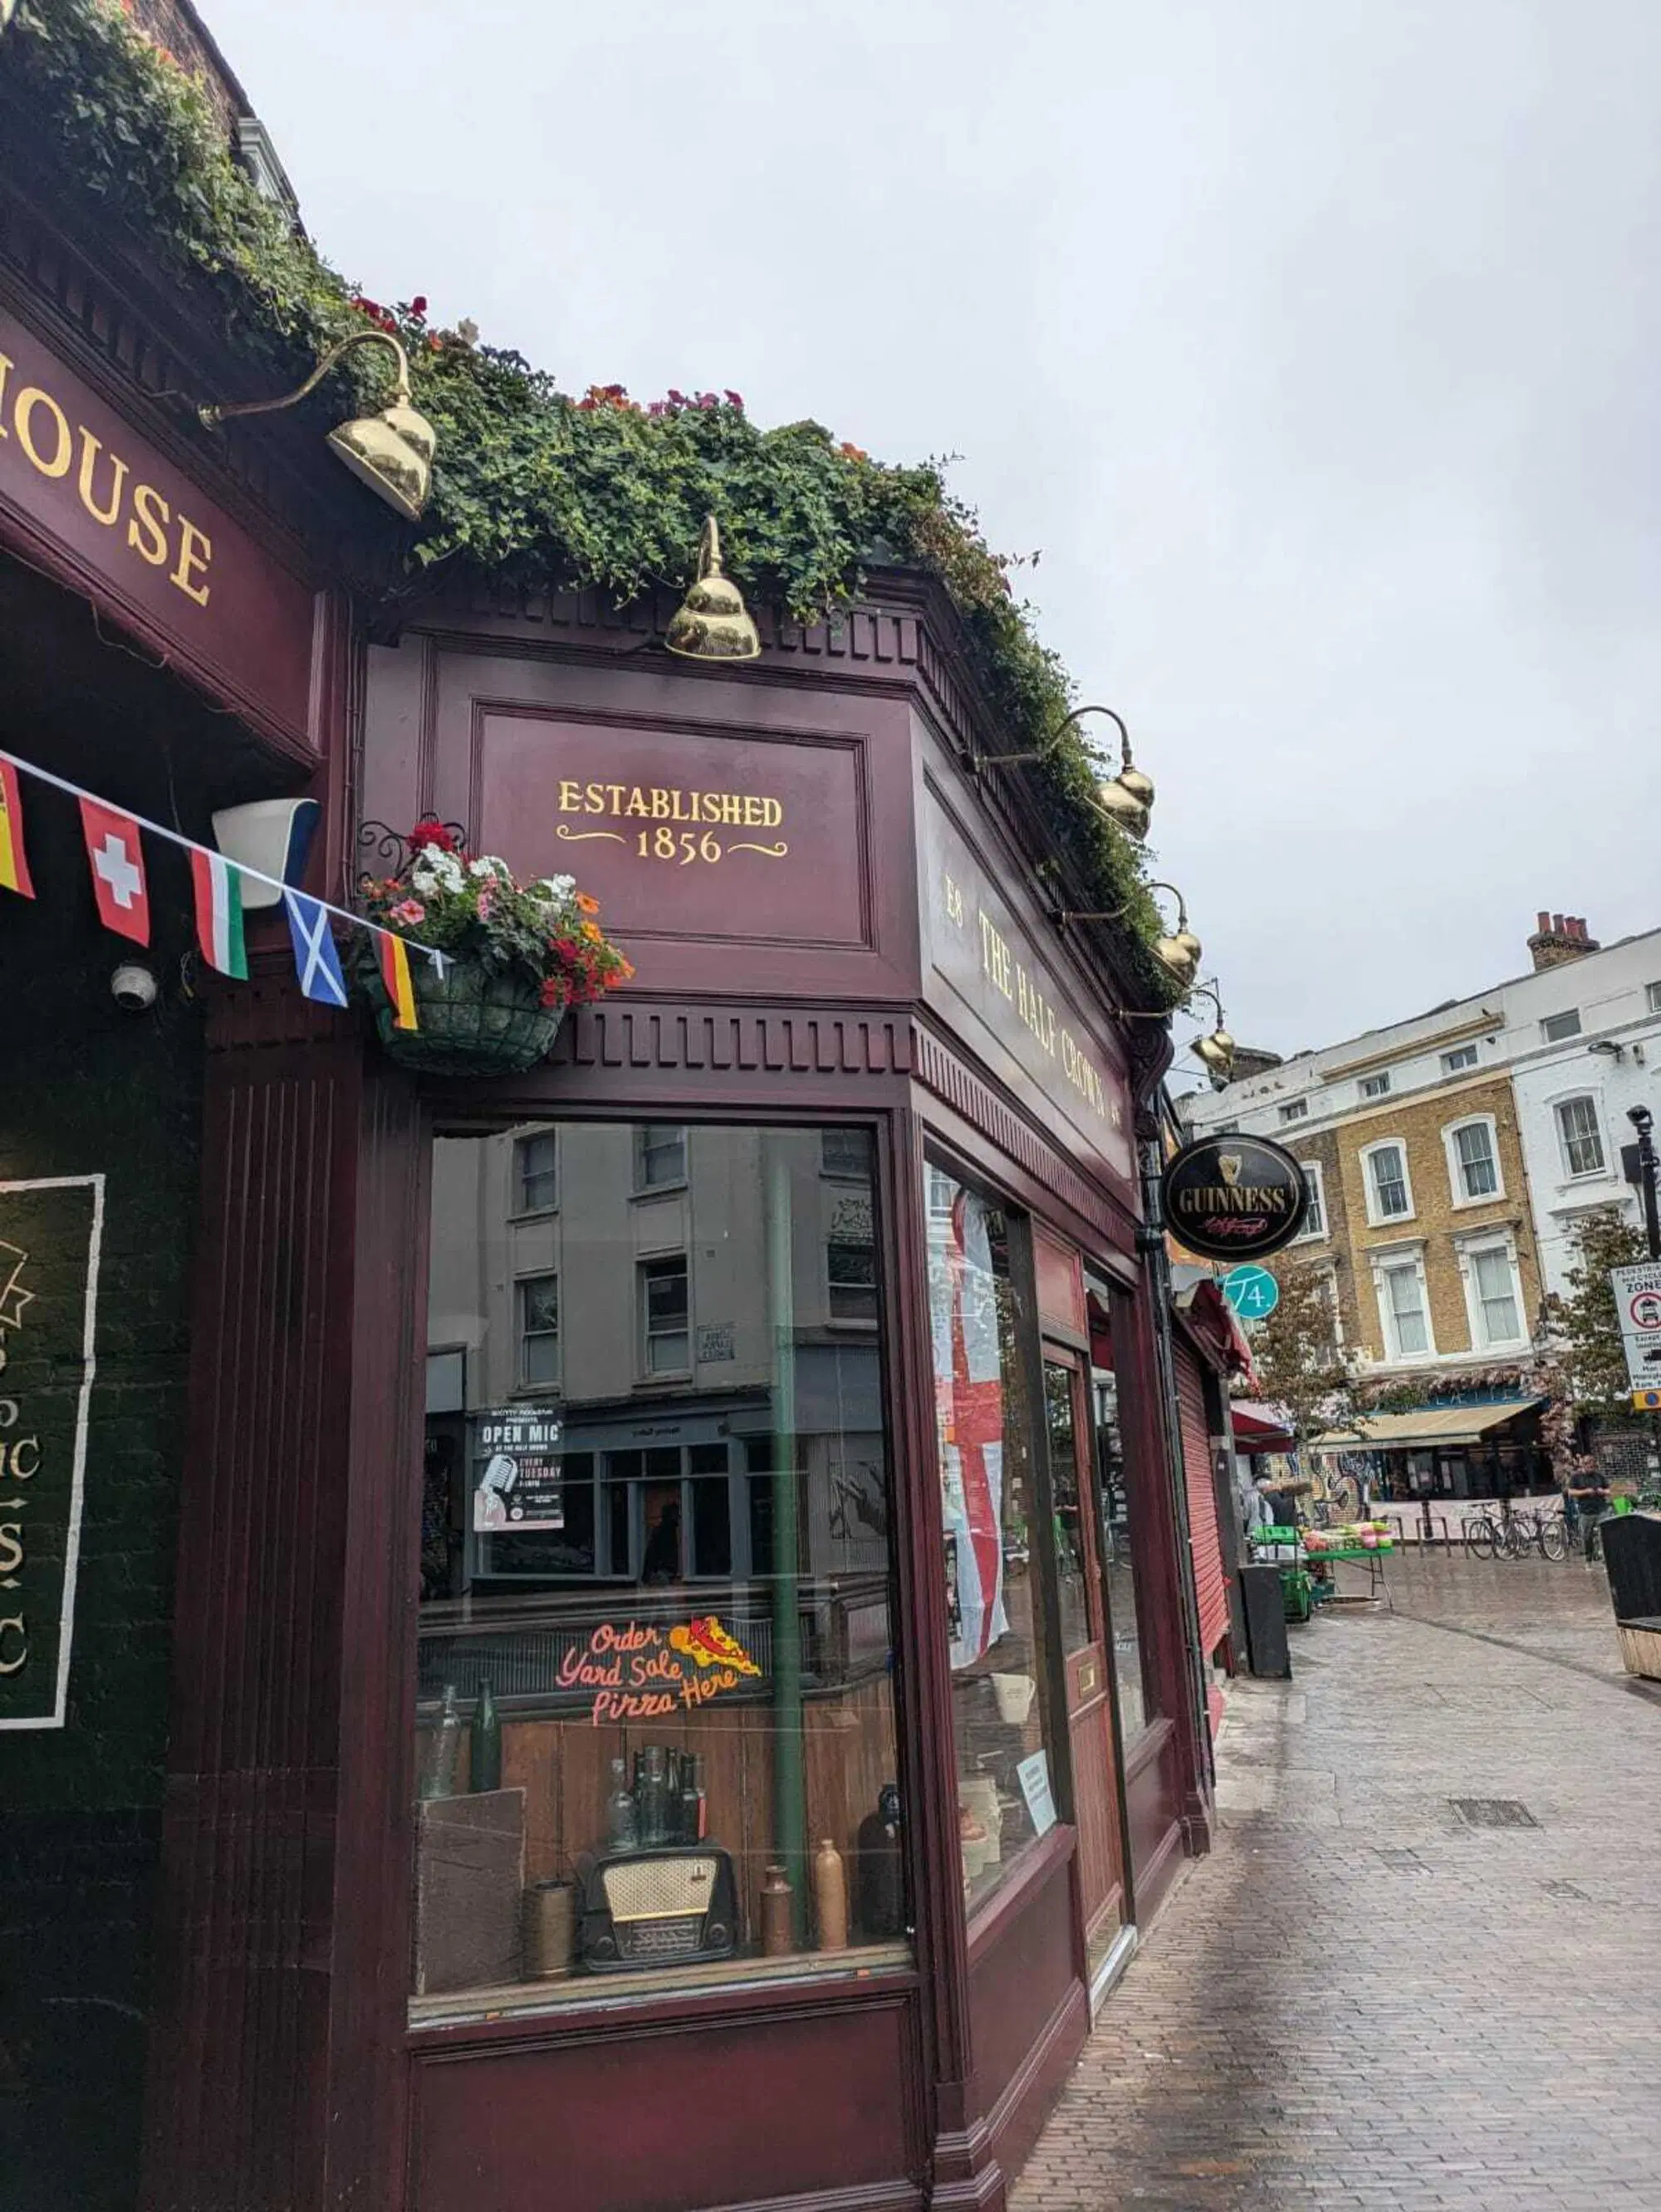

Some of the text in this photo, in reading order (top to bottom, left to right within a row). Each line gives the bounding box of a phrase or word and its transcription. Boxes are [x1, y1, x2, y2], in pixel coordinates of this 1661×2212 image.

[557, 781, 782, 827] ESTABLISHED
[637, 827, 722, 865] 1856
[978, 906, 1013, 1002] THE
[1017, 962, 1056, 1058] HALF
[1061, 1029, 1105, 1118] CROWN
[1179, 1187, 1286, 1213] GUINNESS
[483, 1424, 559, 1443] OPEN MIC
[520, 1466, 561, 1478] TUESDAY
[590, 1621, 663, 1654] Order
[555, 1647, 684, 1688] Yard Sale
[591, 1669, 738, 1728] Pizza Here
